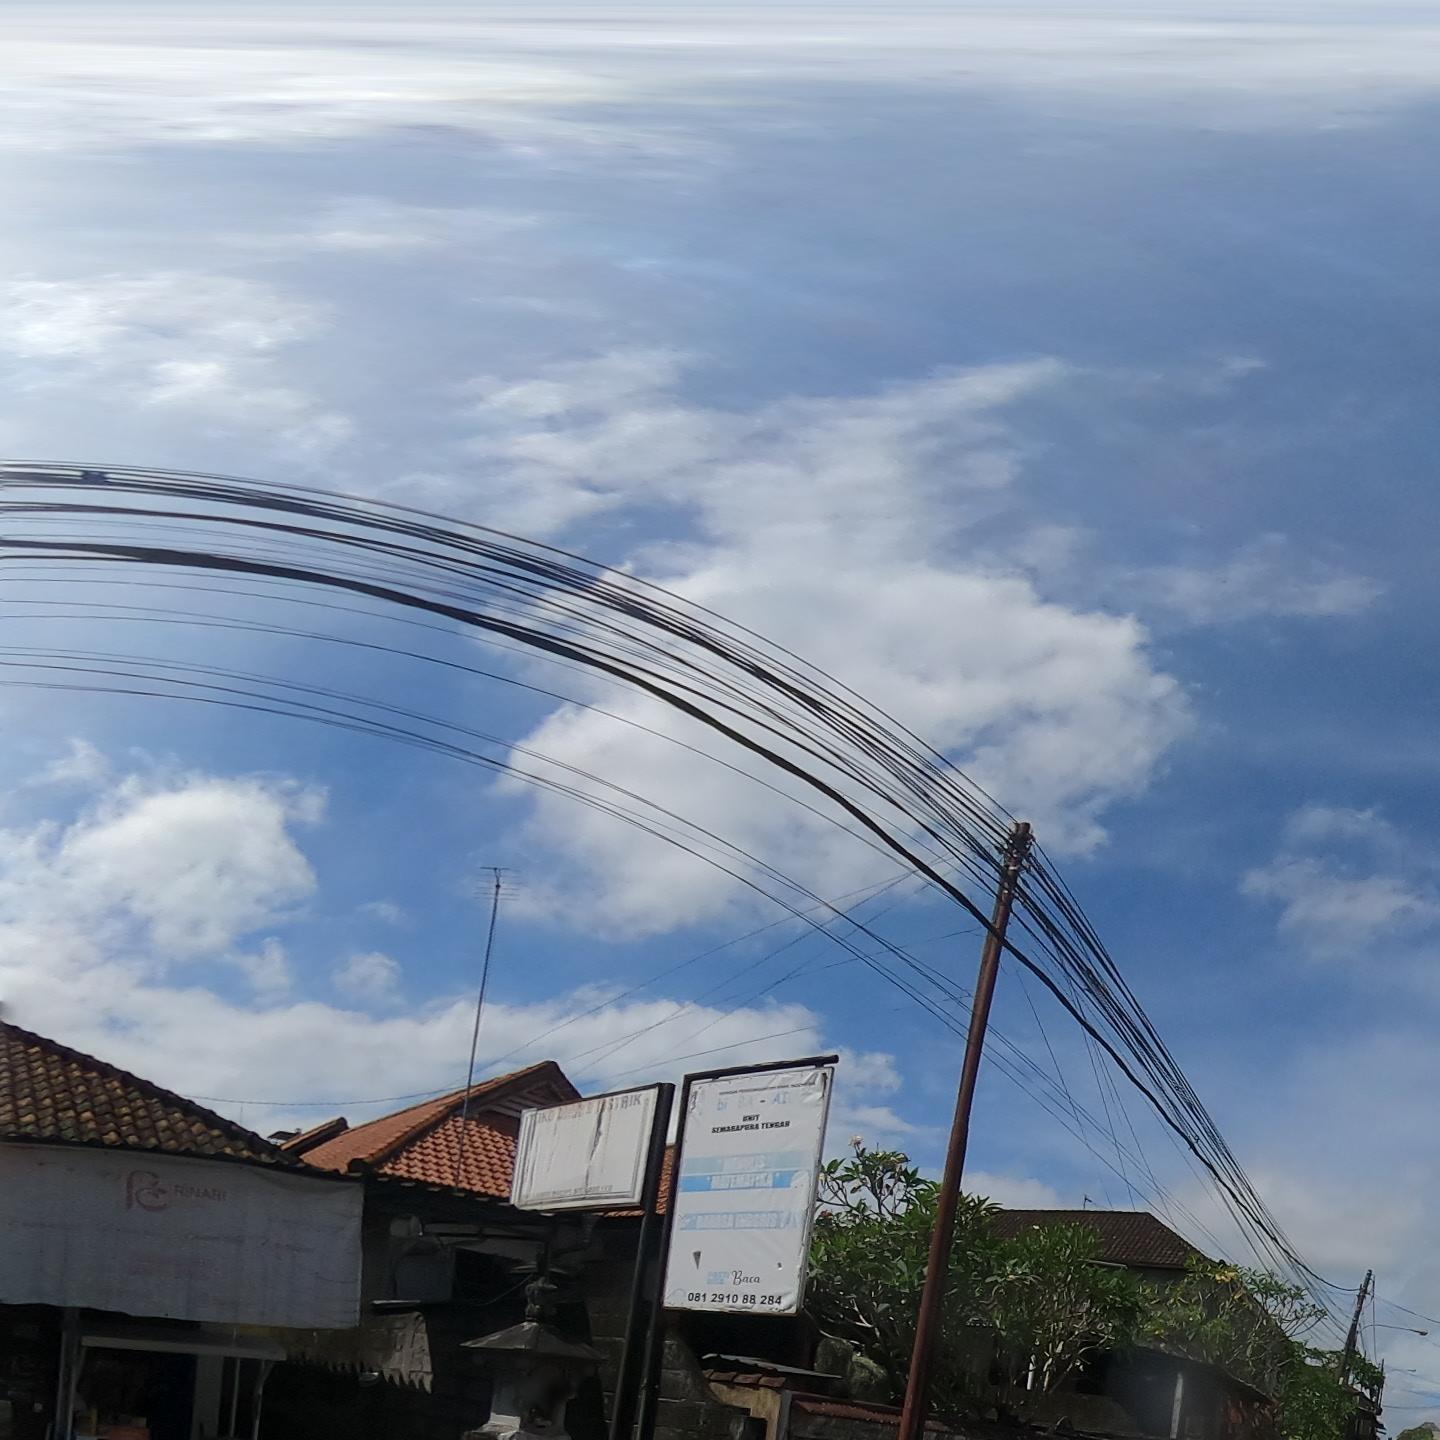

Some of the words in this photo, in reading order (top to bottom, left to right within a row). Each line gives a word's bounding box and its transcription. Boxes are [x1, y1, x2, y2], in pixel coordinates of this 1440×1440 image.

[742, 1114, 760, 1122] UNIT
[732, 1270, 761, 1286] Baca
[687, 1292, 707, 1303] 081
[710, 1293, 739, 1304] 2910
[742, 1294, 757, 1305] 88
[760, 1295, 783, 1305] 284
